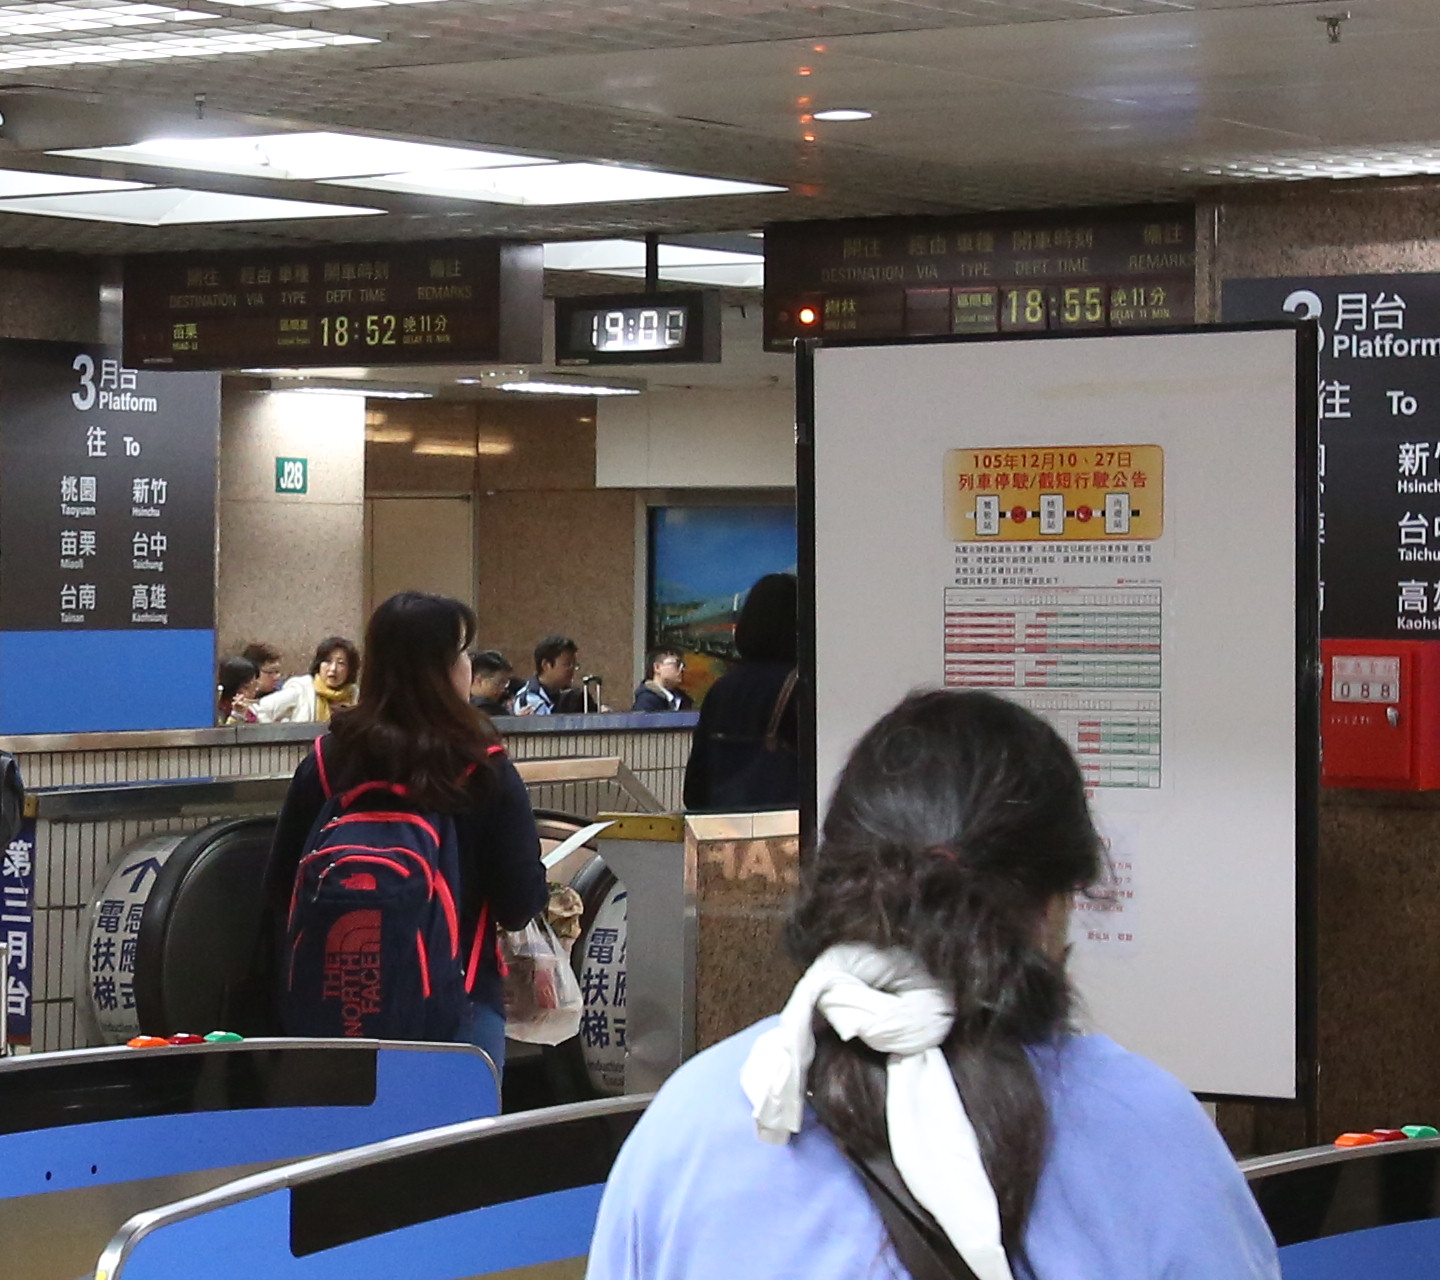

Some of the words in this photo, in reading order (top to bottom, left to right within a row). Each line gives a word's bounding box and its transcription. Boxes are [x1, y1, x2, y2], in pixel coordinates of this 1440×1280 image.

[170, 294, 237, 308] DESTINATION
[360, 288, 386, 302] TIME
[417, 286, 472, 300] REMARKS
[1007, 286, 1102, 324] 18:55
[1334, 293, 1406, 331] 月台
[321, 315, 396, 346] 18:52
[72, 354, 96, 411] 3
[99, 391, 157, 412] Platform
[1319, 380, 1351, 418] 往
[1387, 391, 1417, 415] To
[87, 426, 107, 457] 往
[123, 437, 140, 456] To
[61, 476, 97, 503] 桃園
[280, 461, 304, 491] J28
[132, 478, 167, 504] 新竹
[61, 504, 96, 518] Taoyuan
[61, 530, 96, 556] 苗栗
[132, 531, 167, 557] 台中
[61, 584, 96, 610] 台南
[132, 584, 167, 610] 高雄
[1, 840, 32, 1016] 第三月台
[92, 900, 125, 1011] 電扶梯
[360, 953, 381, 1013] FACE
[582, 928, 619, 1048] 電扶梯
